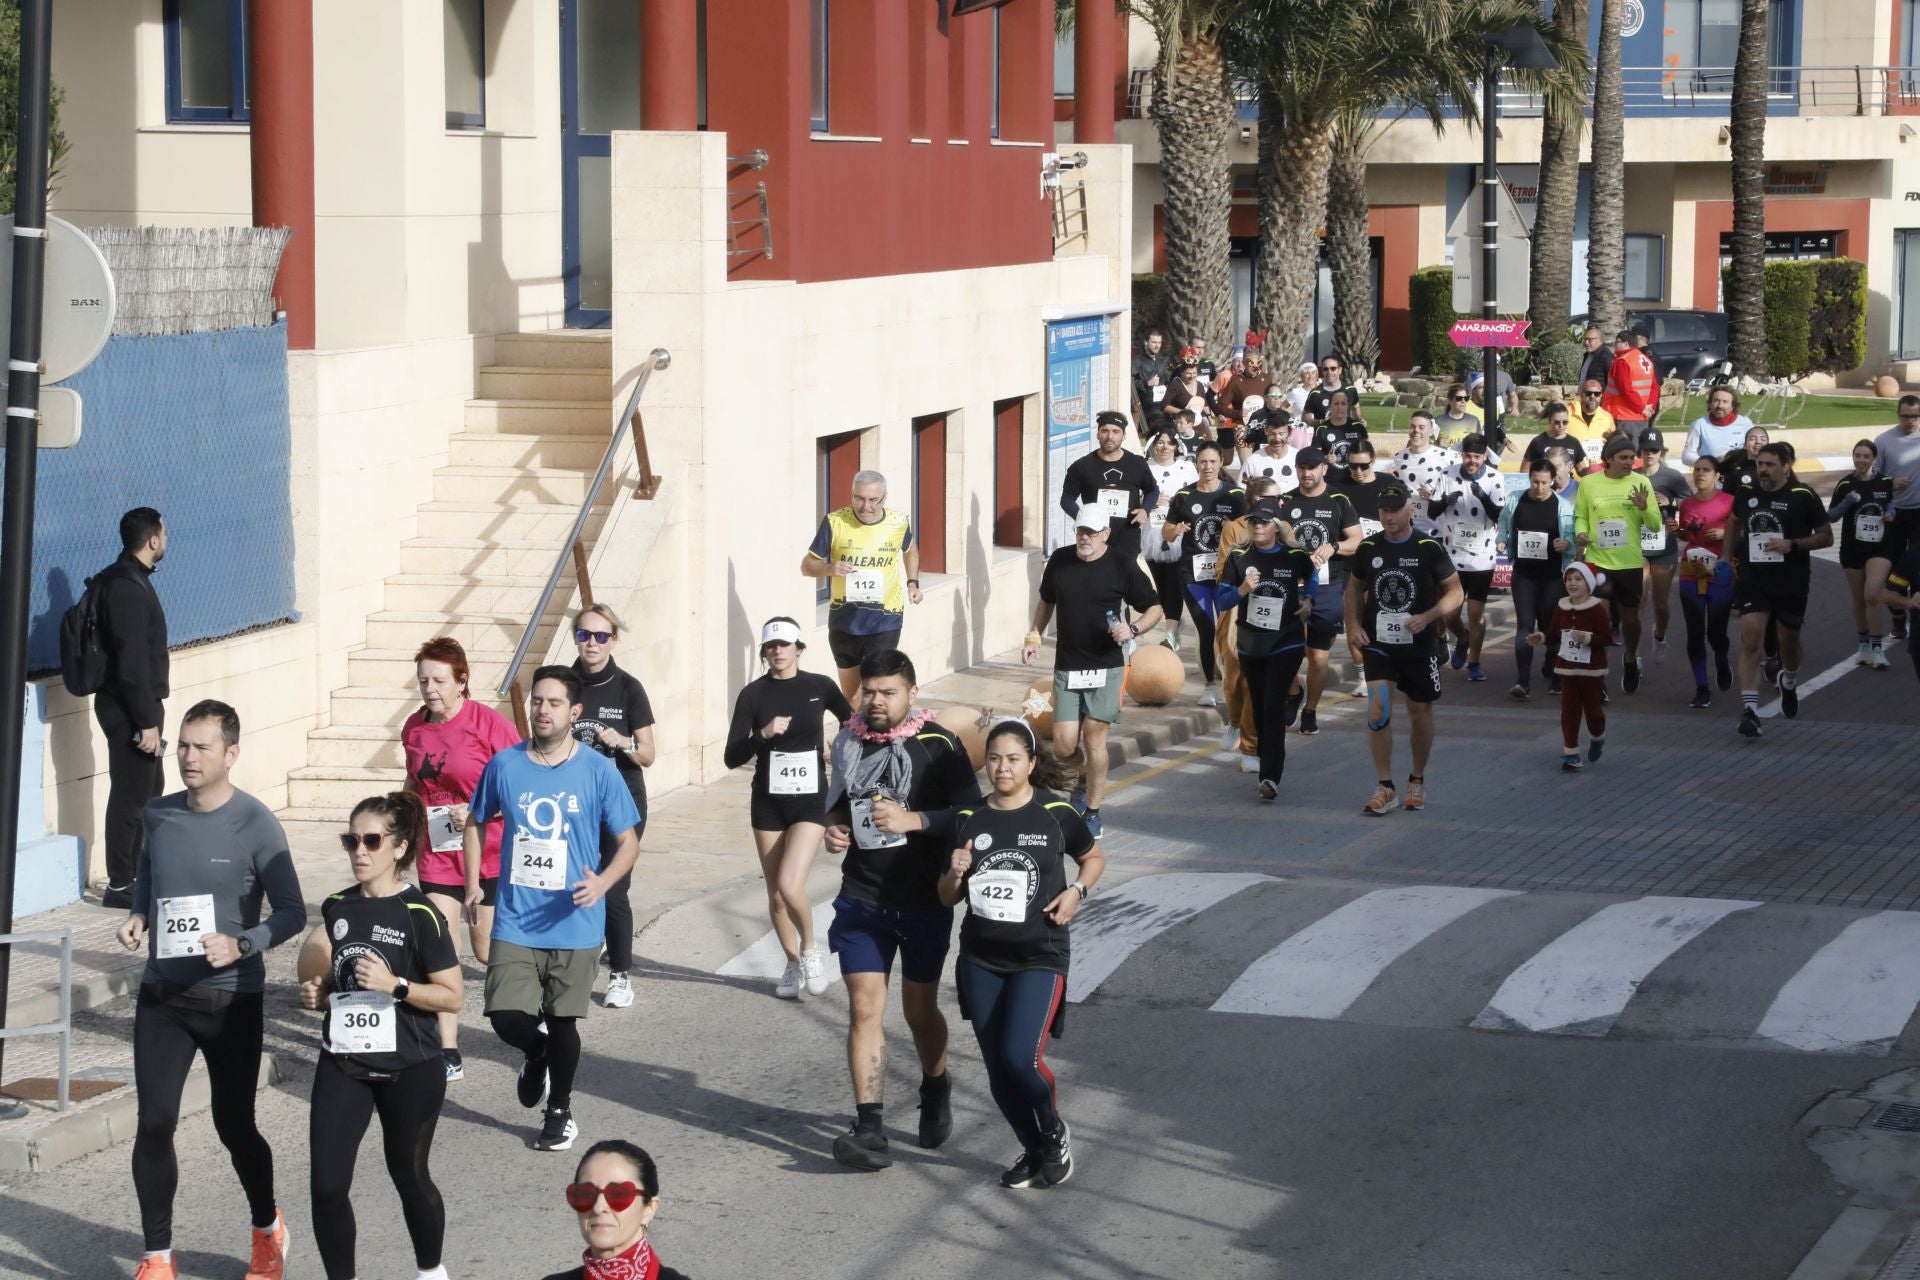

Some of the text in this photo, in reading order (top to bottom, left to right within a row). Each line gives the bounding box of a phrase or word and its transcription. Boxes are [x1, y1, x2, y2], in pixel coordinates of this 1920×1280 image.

[1460, 530, 1477, 538] 364
[1525, 541, 1541, 549] 137
[855, 581, 876, 589] 112
[1256, 607, 1271, 616] 25
[1387, 623, 1401, 631] 26
[780, 767, 807, 777] 416
[523, 854, 554, 869] 244
[990, 851, 1025, 862] ROSCÓN
[981, 886, 1014, 900] 422
[167, 917, 200, 933] 262
[373, 925, 400, 937] Marina
[382, 934, 404, 946] Dénia
[344, 1013, 380, 1028] 360
